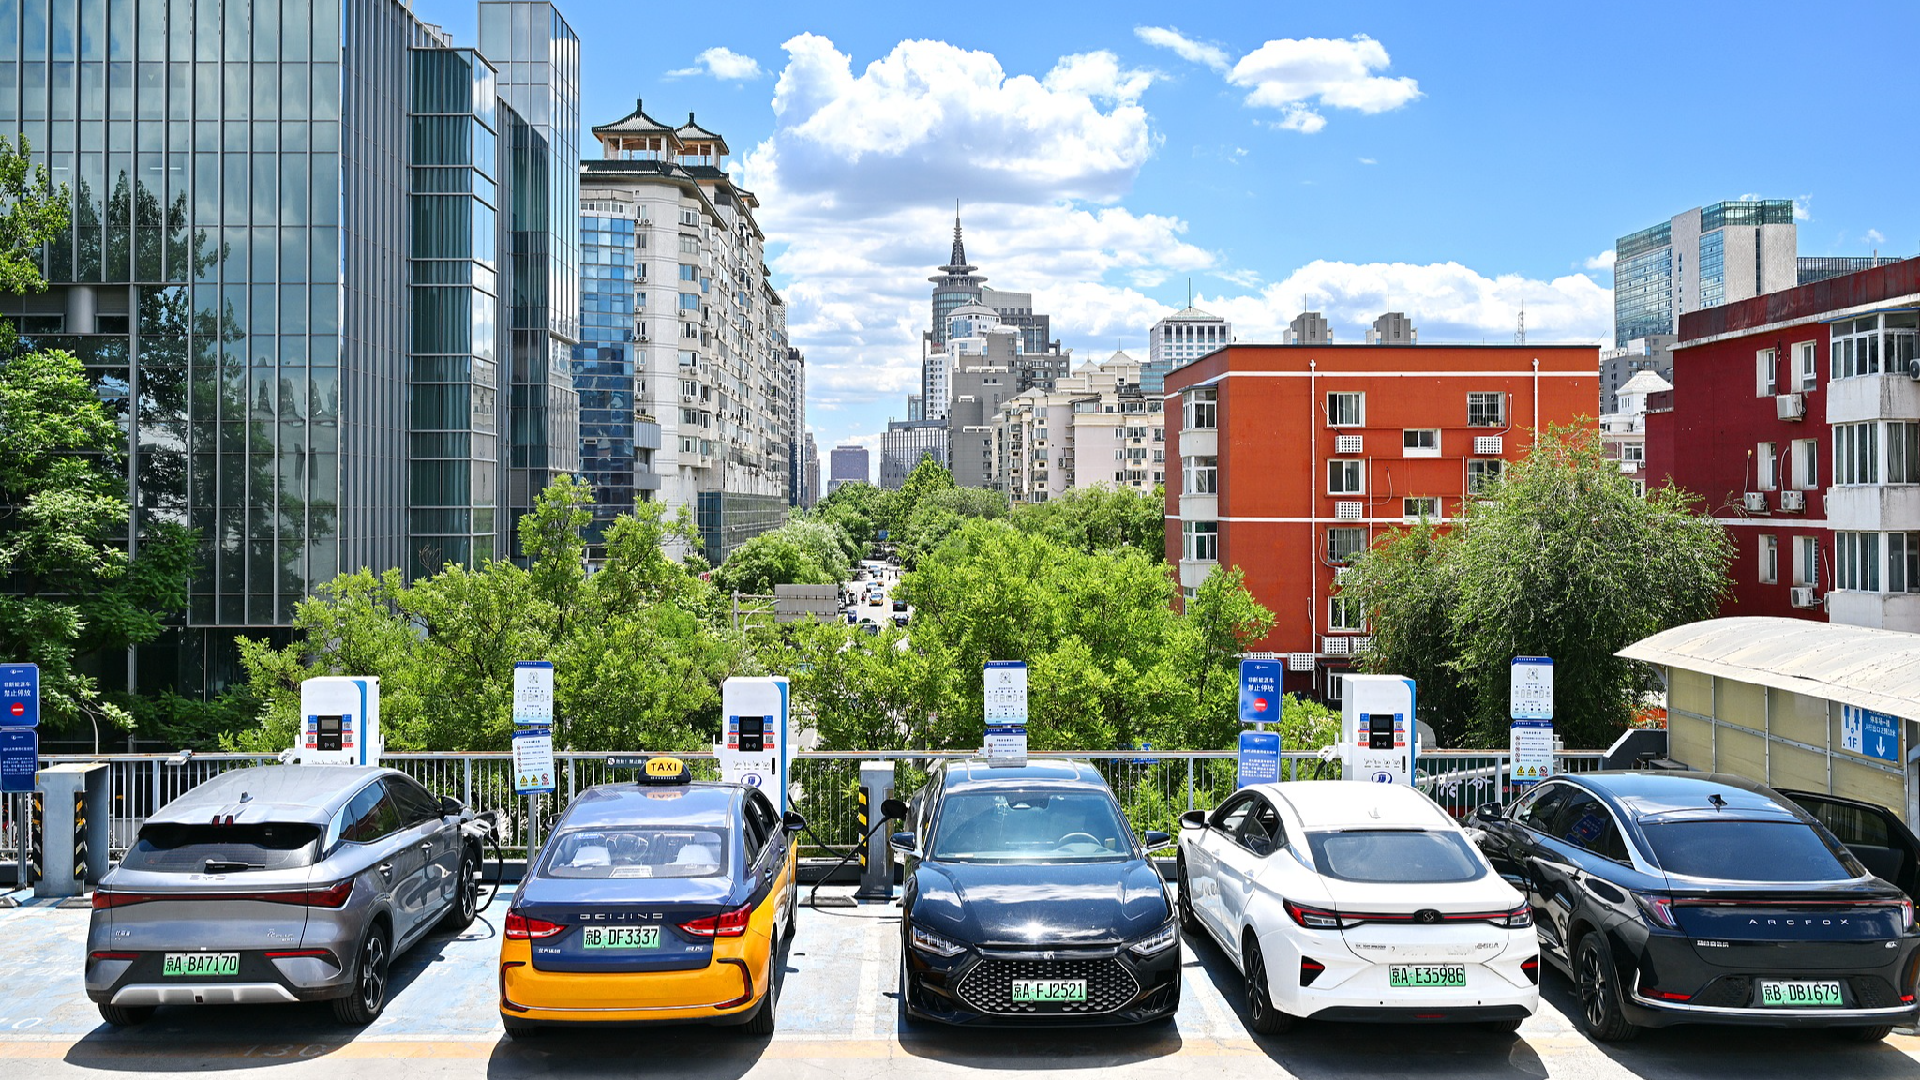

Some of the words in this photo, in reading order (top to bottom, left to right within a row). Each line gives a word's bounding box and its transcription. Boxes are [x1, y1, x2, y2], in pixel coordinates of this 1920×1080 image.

[3, 689, 32, 698] 禁止停放
[1847, 736, 1858, 749] 1F
[650, 762, 678, 772] TAXI
